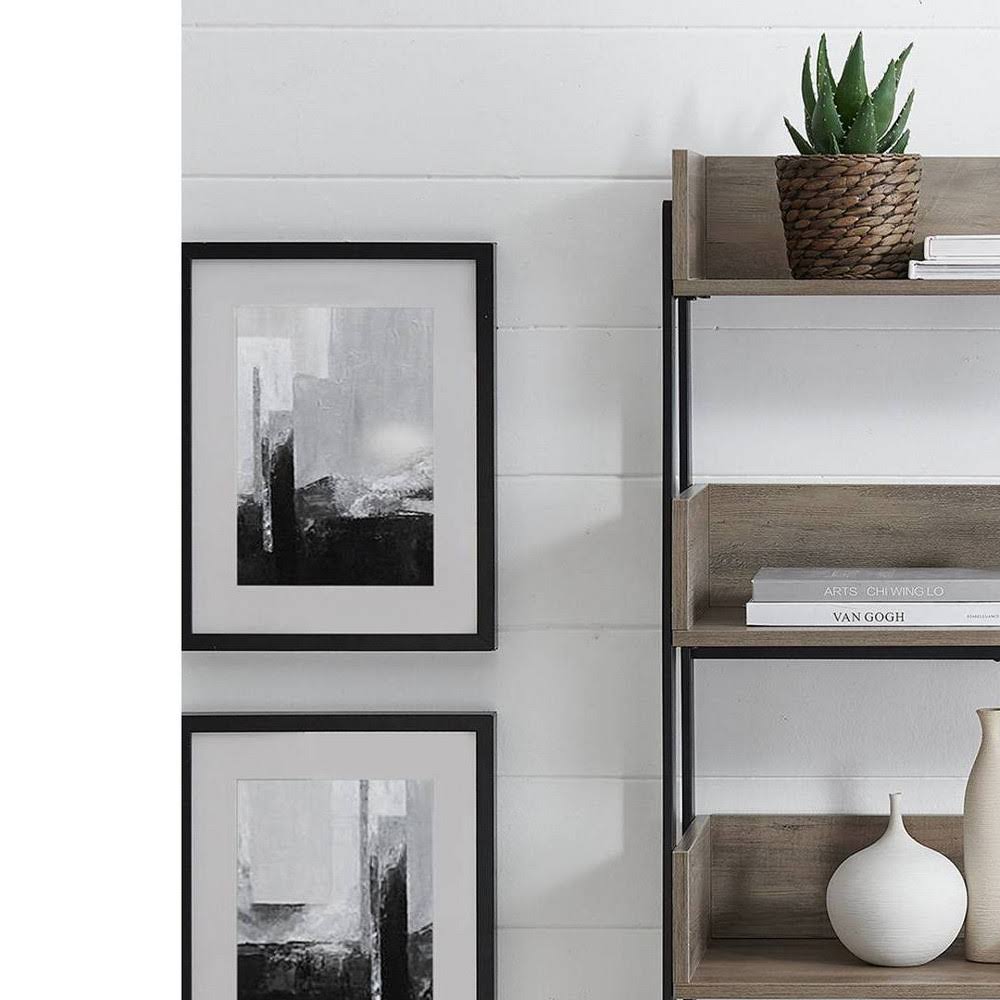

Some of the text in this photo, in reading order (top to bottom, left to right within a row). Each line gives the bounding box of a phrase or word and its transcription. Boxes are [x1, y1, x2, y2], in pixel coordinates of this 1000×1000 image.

[824, 586, 944, 597] ARTS CHI WING LO
[833, 612, 905, 622] VAN GOGH
